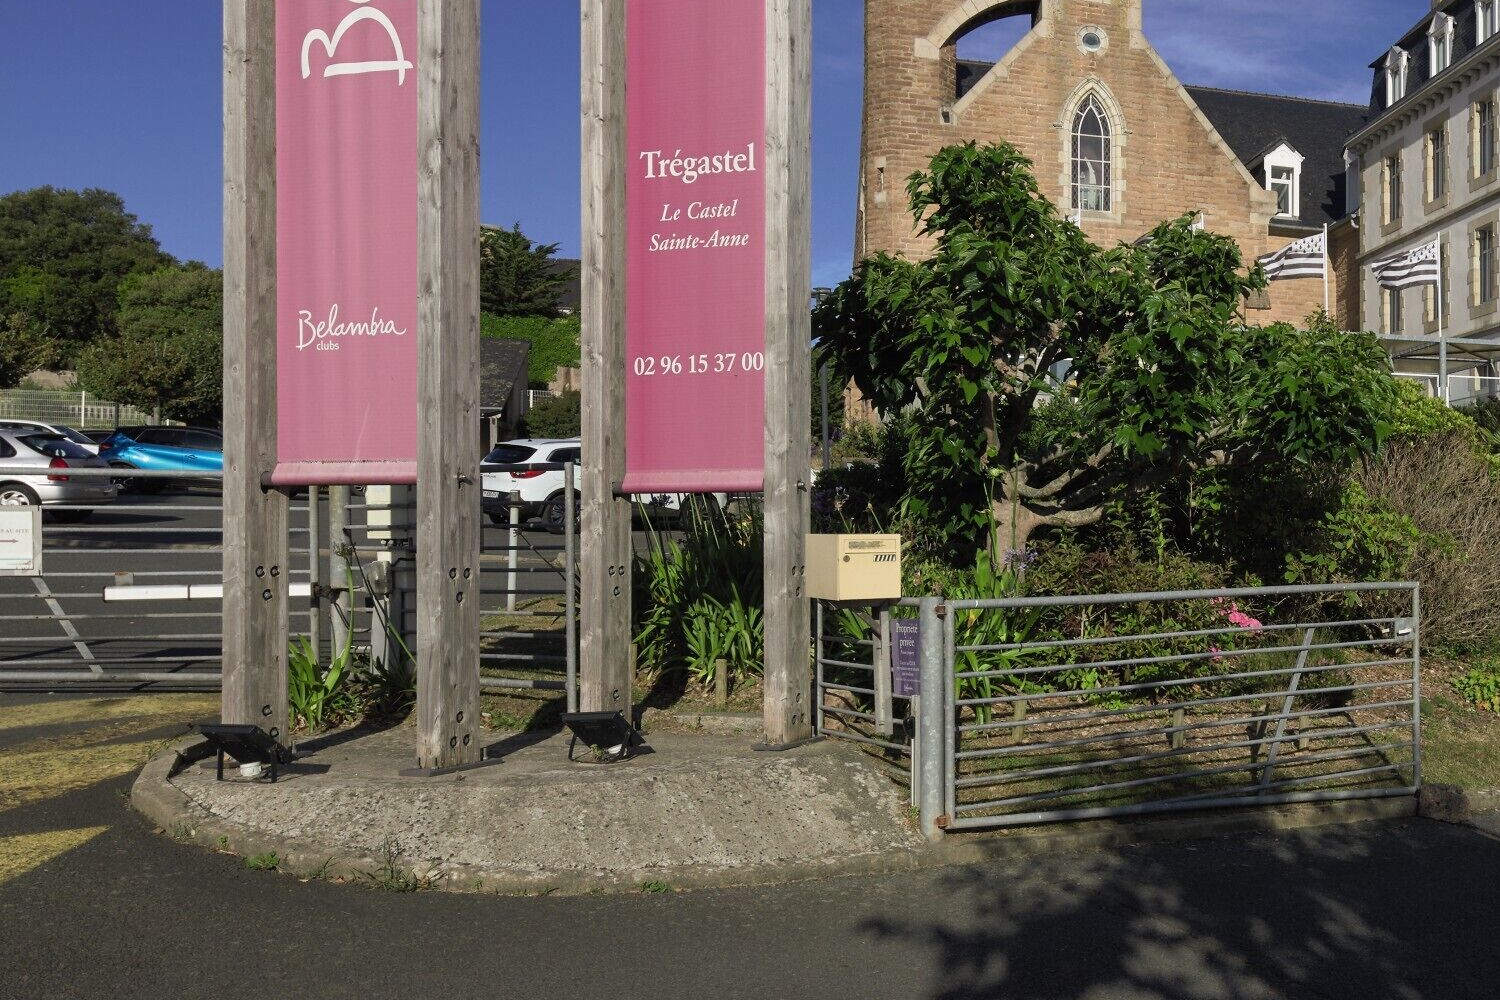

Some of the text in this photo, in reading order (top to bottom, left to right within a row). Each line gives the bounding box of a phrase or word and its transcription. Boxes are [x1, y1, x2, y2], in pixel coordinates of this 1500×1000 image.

[639, 142, 756, 184] Trégastel
[660, 198, 739, 222] Le Castel
[649, 229, 750, 252] Sainte-Anne
[295, 303, 407, 352] Belambra
[316, 340, 340, 351] clubs
[634, 352, 764, 376] 02 96 15 37 00
